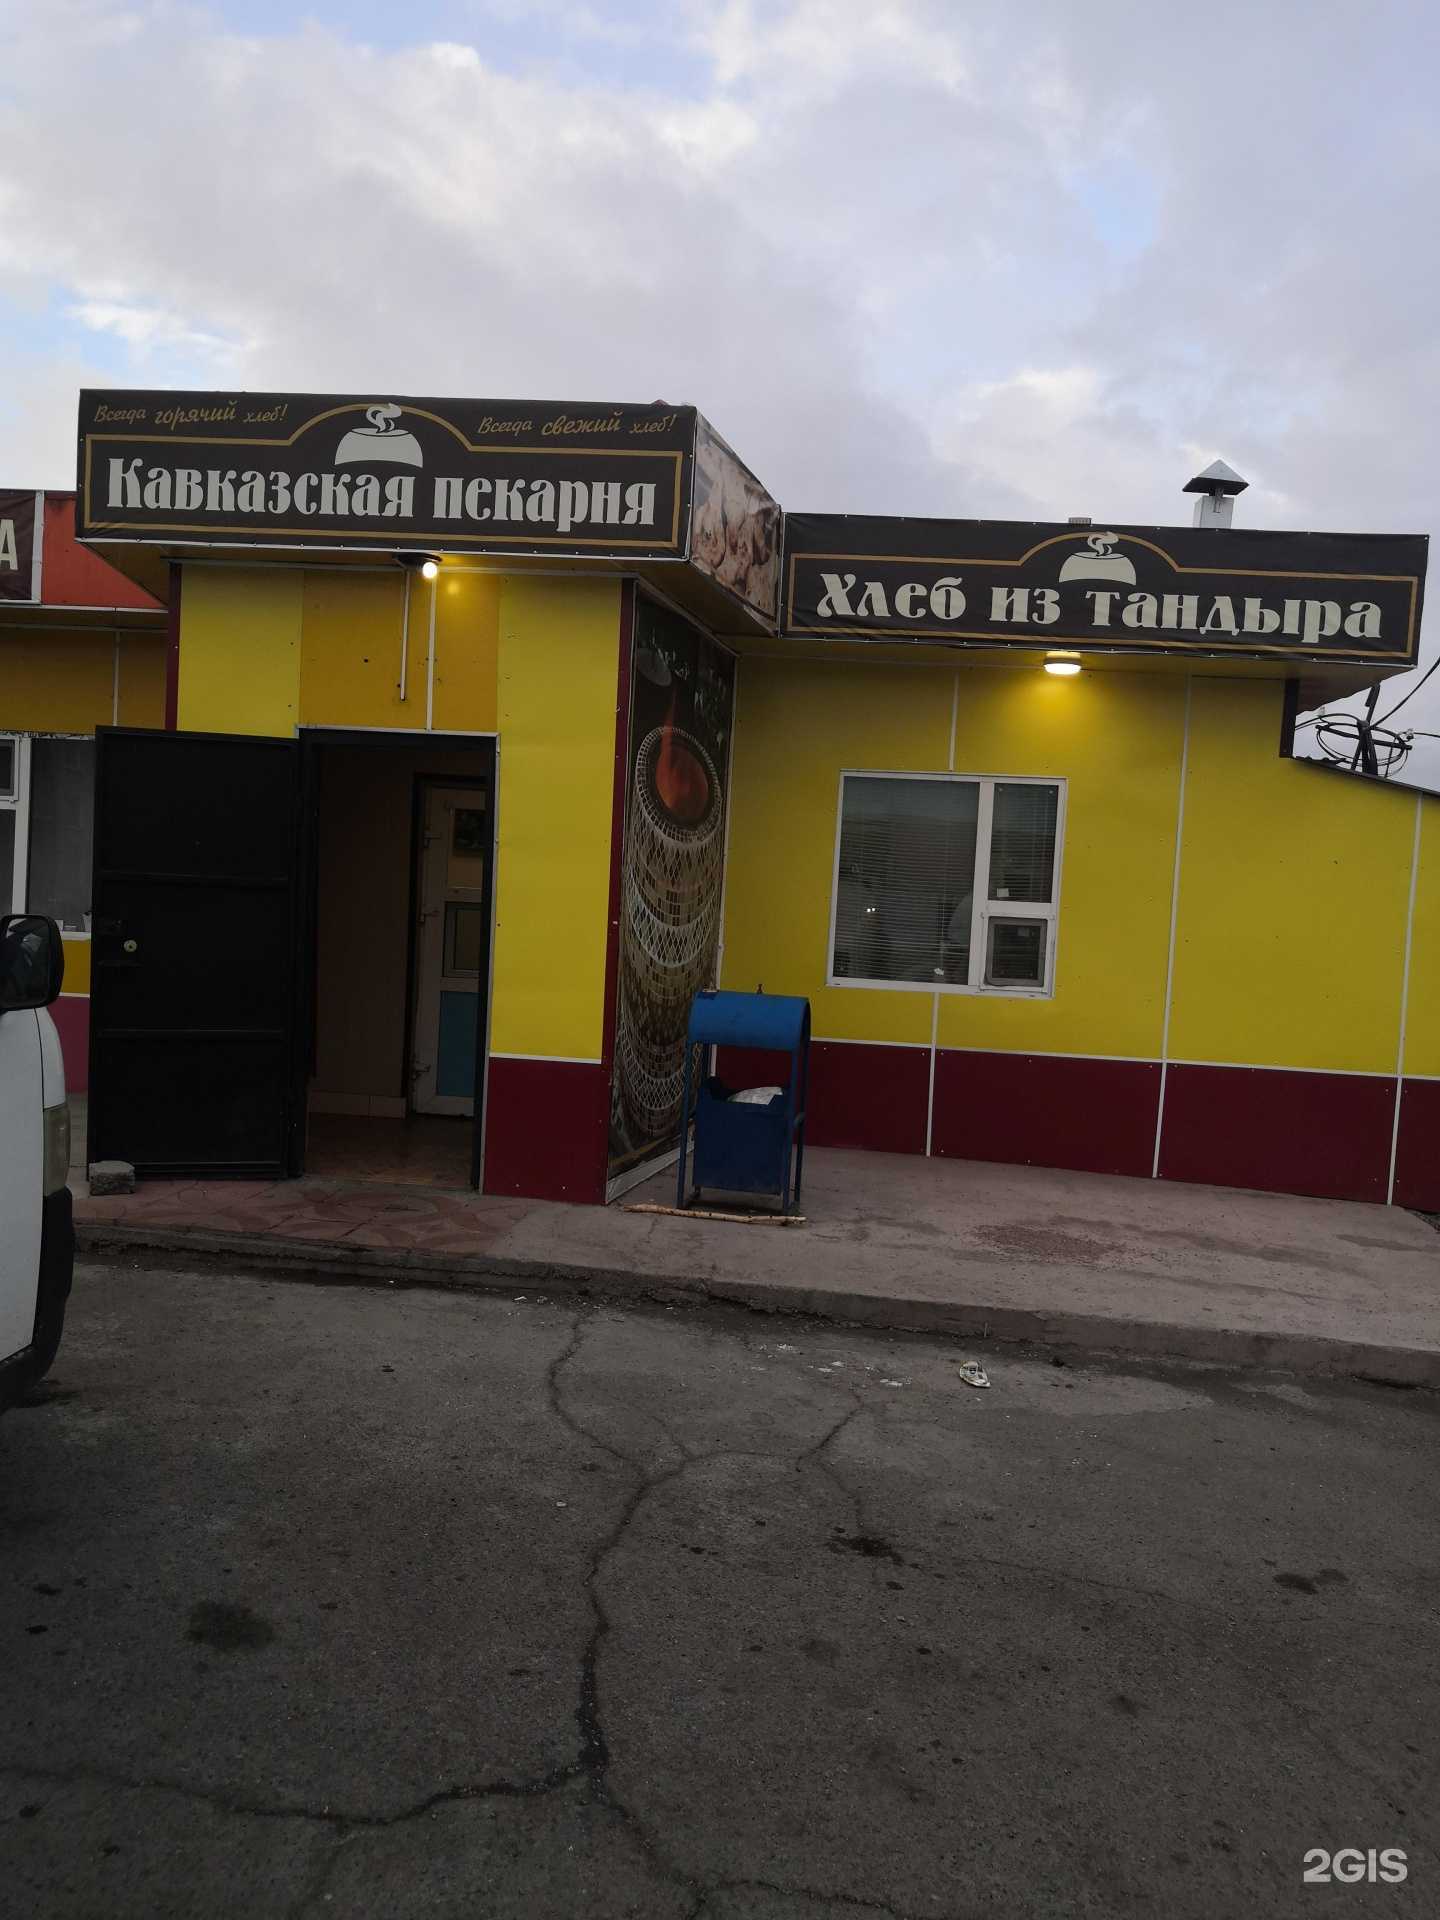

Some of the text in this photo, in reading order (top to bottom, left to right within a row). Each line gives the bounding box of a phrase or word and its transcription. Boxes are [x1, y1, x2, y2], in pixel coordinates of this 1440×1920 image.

[94, 400, 289, 431] Всегда горячий хлеб!
[478, 411, 677, 436] Всегда свежий хлеб!
[107, 457, 657, 532] Кавказская пекарня
[816, 573, 1382, 644] Хлеб из тандыра
